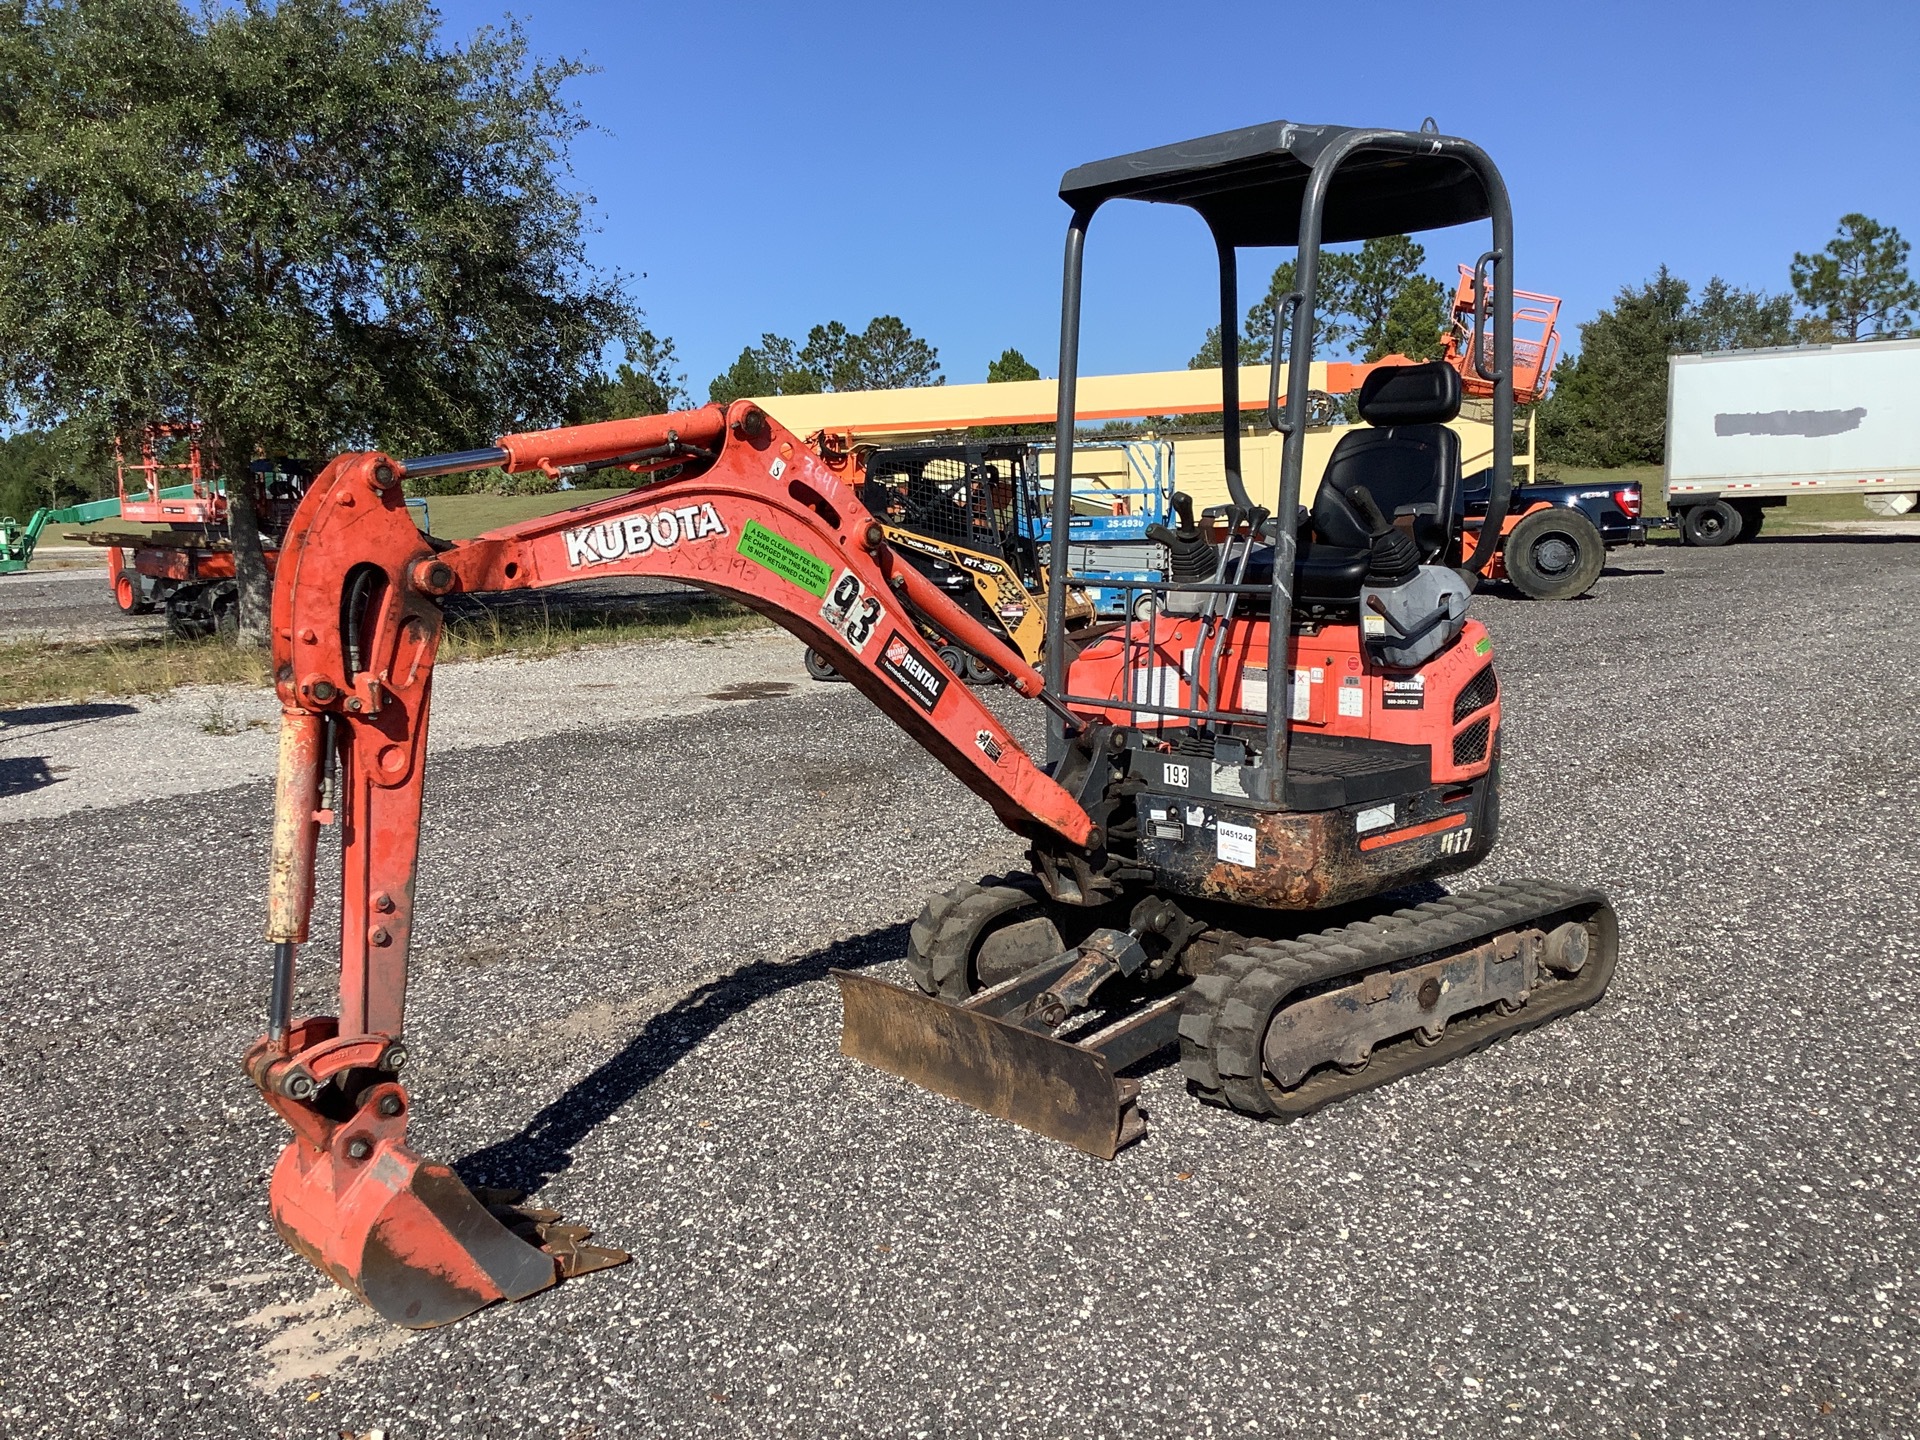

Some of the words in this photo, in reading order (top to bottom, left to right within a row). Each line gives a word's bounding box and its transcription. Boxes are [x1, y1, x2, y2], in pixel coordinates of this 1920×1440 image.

[564, 502, 727, 567] KUBOTA
[757, 531, 770, 543] $200
[770, 539, 799, 560] CLEANING
[800, 556, 811, 566] FEE
[811, 562, 824, 574] WILL
[743, 533, 752, 542] BE
[752, 538, 782, 559] CHARGED
[788, 558, 801, 569] THIS
[801, 566, 826, 584] MACHINE
[754, 549, 767, 560] NOT
[767, 556, 798, 578] RETURNED
[798, 573, 818, 589] CLEAN
[884, 660, 932, 707] homedepot.com/rental
[901, 653, 940, 697] RENTAL
[1394, 681, 1424, 690] RENTAL
[1166, 765, 1188, 786] 193
[1219, 828, 1254, 843] U451242
